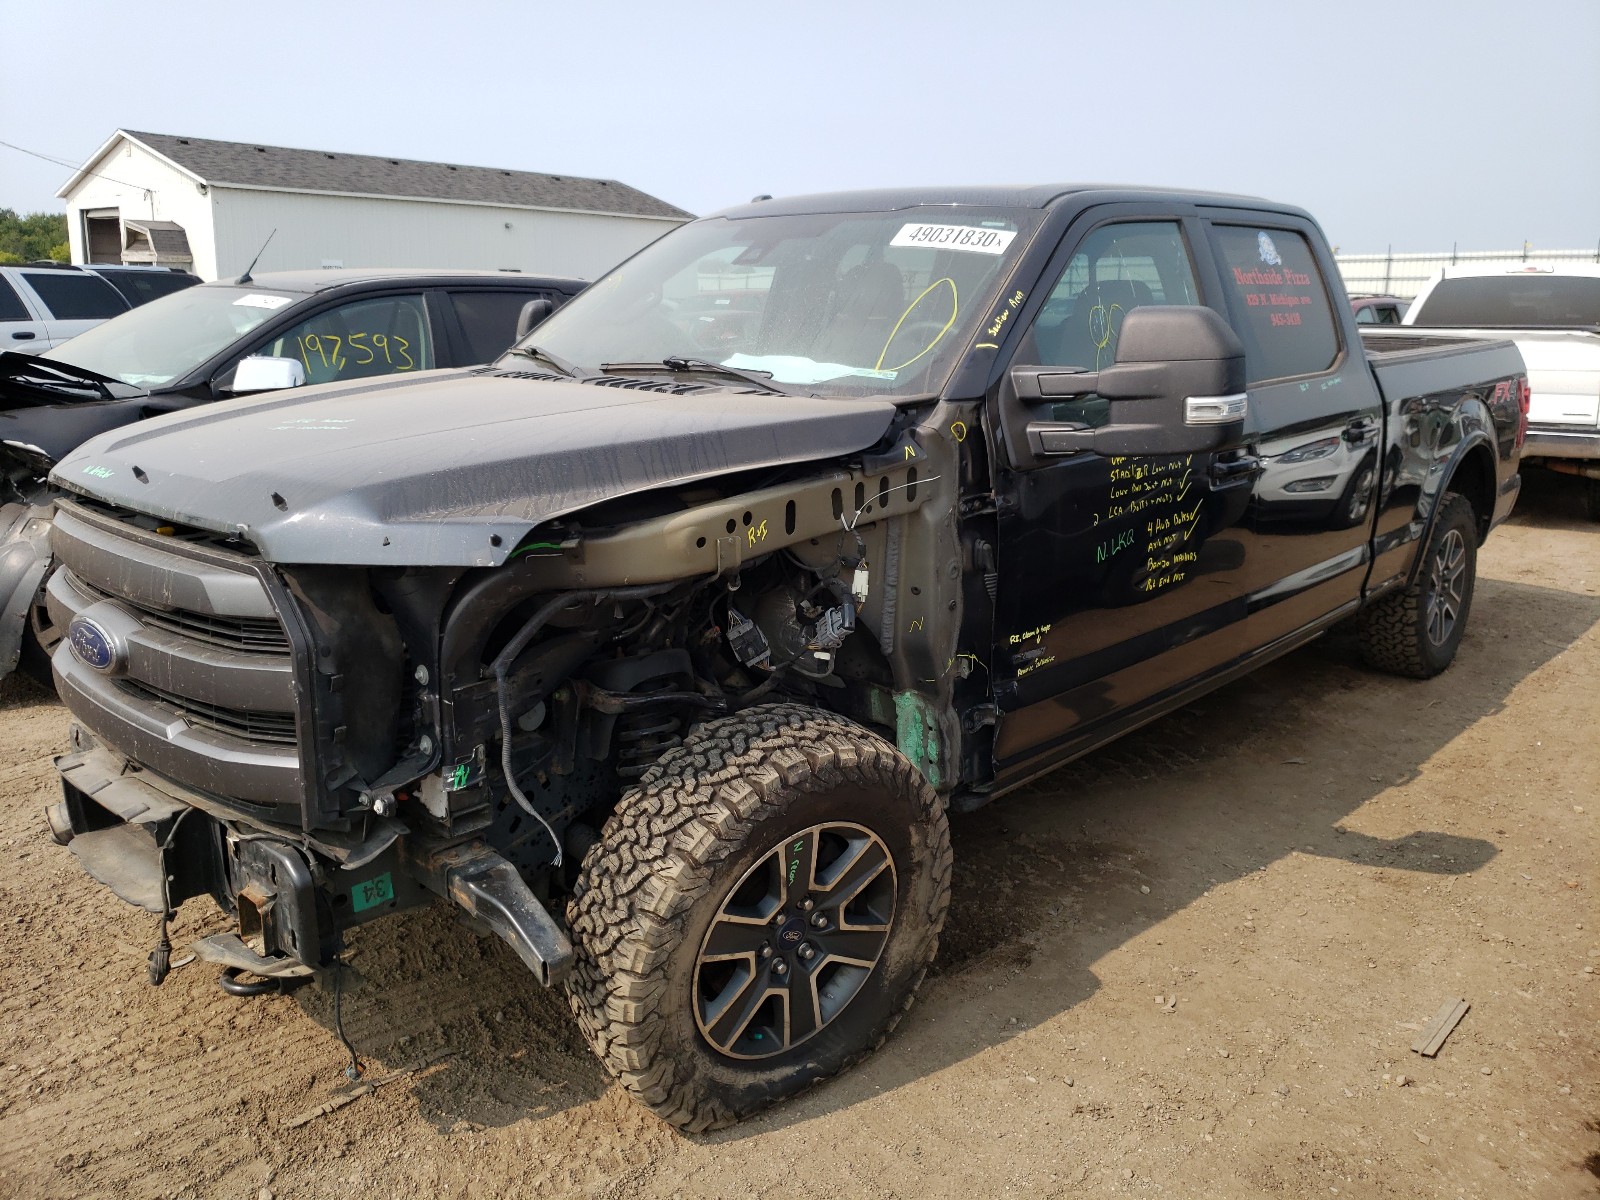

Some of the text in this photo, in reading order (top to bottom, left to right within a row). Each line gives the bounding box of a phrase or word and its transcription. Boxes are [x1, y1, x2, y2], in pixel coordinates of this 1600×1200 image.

[1232, 266, 1312, 285] Northside Pizza
[298, 333, 414, 375] 197,593
[1112, 528, 1135, 555] LKQ
[75, 627, 101, 663] Ford
